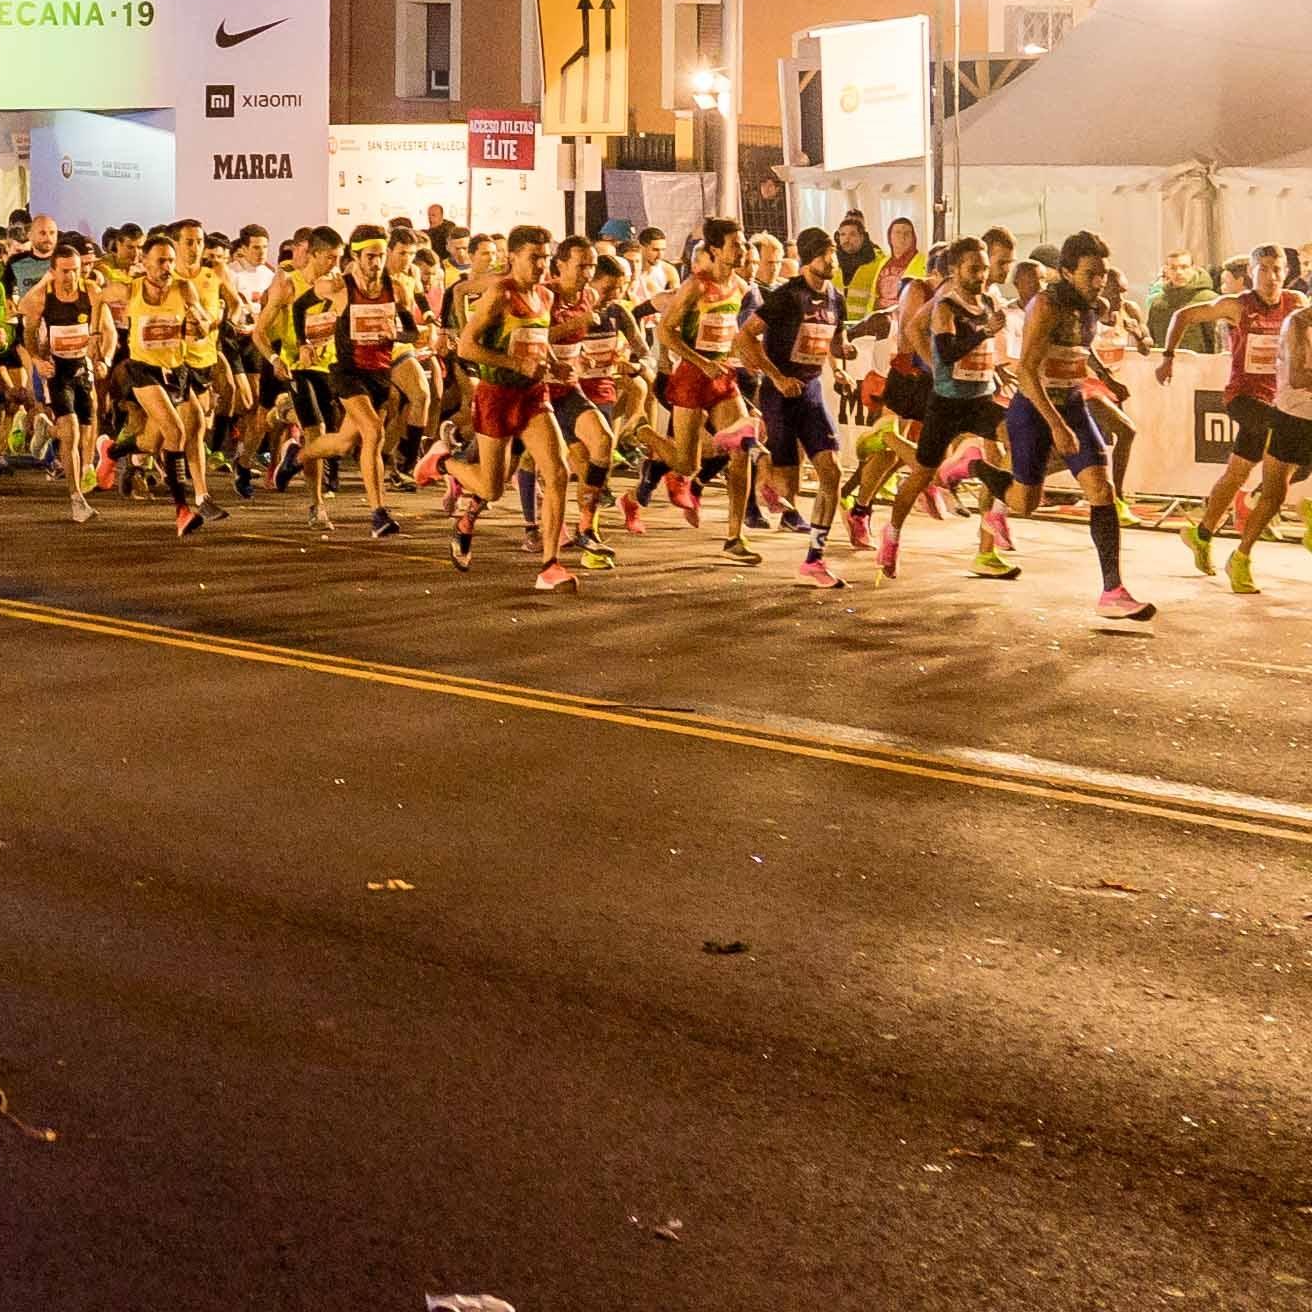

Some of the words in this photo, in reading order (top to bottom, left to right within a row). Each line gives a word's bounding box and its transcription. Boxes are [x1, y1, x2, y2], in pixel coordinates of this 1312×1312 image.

[241, 92, 303, 108] xiaomi
[469, 119, 499, 134] ACCESO
[499, 121, 535, 135] ATLETAS
[483, 134, 518, 161] ÉLITE
[213, 153, 293, 180] MARCA
